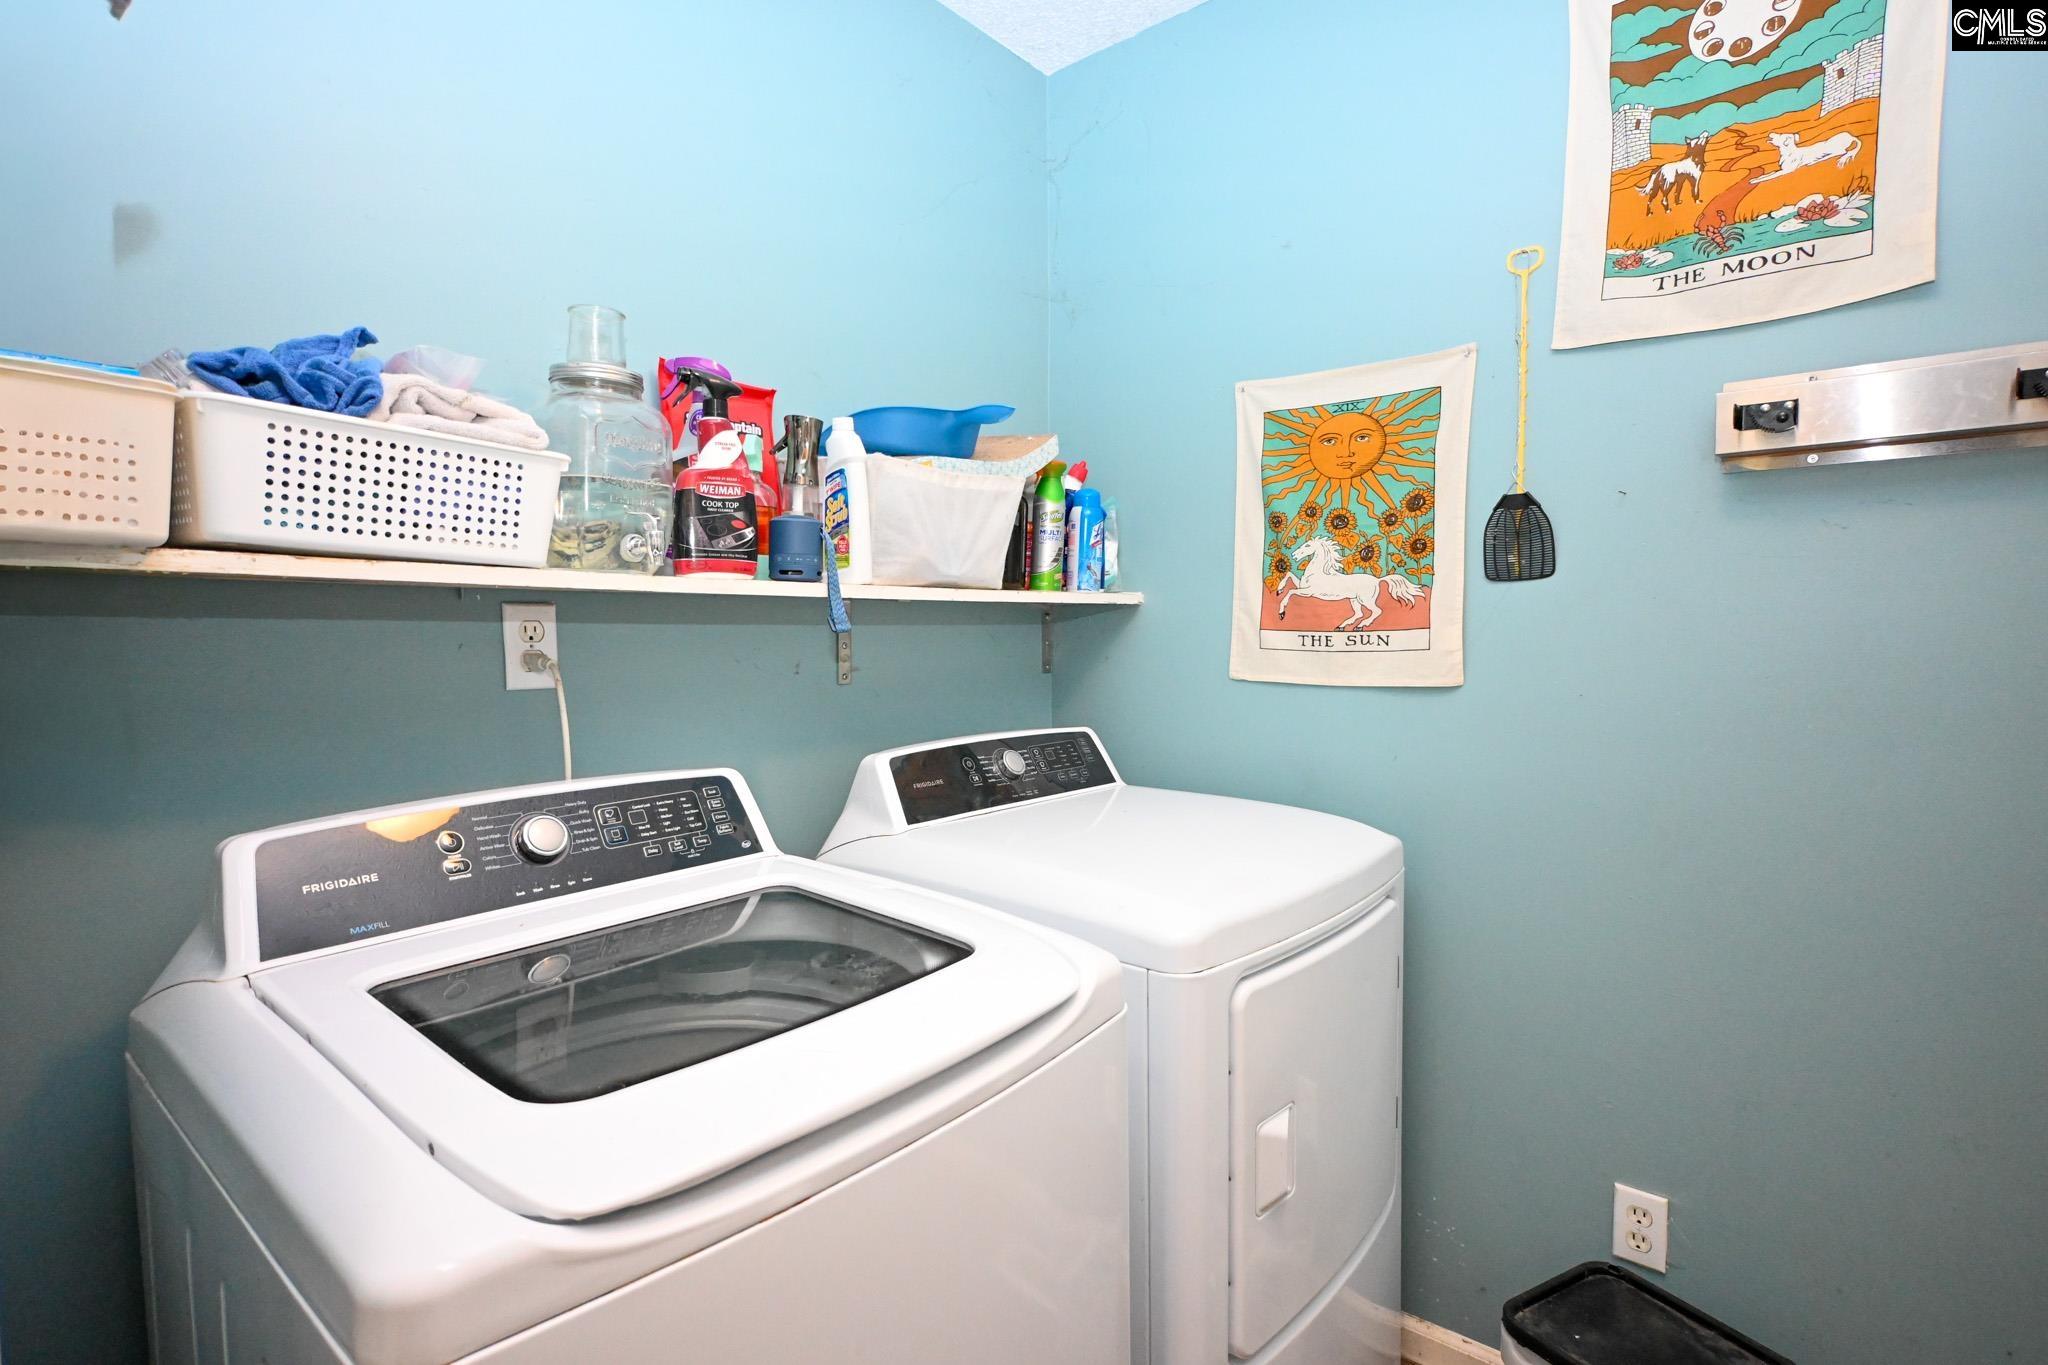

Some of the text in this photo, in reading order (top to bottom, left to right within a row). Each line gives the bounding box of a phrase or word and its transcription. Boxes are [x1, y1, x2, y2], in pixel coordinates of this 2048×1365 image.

[1652, 244, 1816, 292] THE MOON
[1332, 400, 1366, 413] XIX
[700, 484, 741, 495] WEIMAN
[1298, 635, 1390, 647] THE SUN
[913, 779, 944, 788] FRIGIDAIRE
[302, 872, 379, 894] FRIGIDAIRE
[350, 921, 390, 935] MAXFILL
